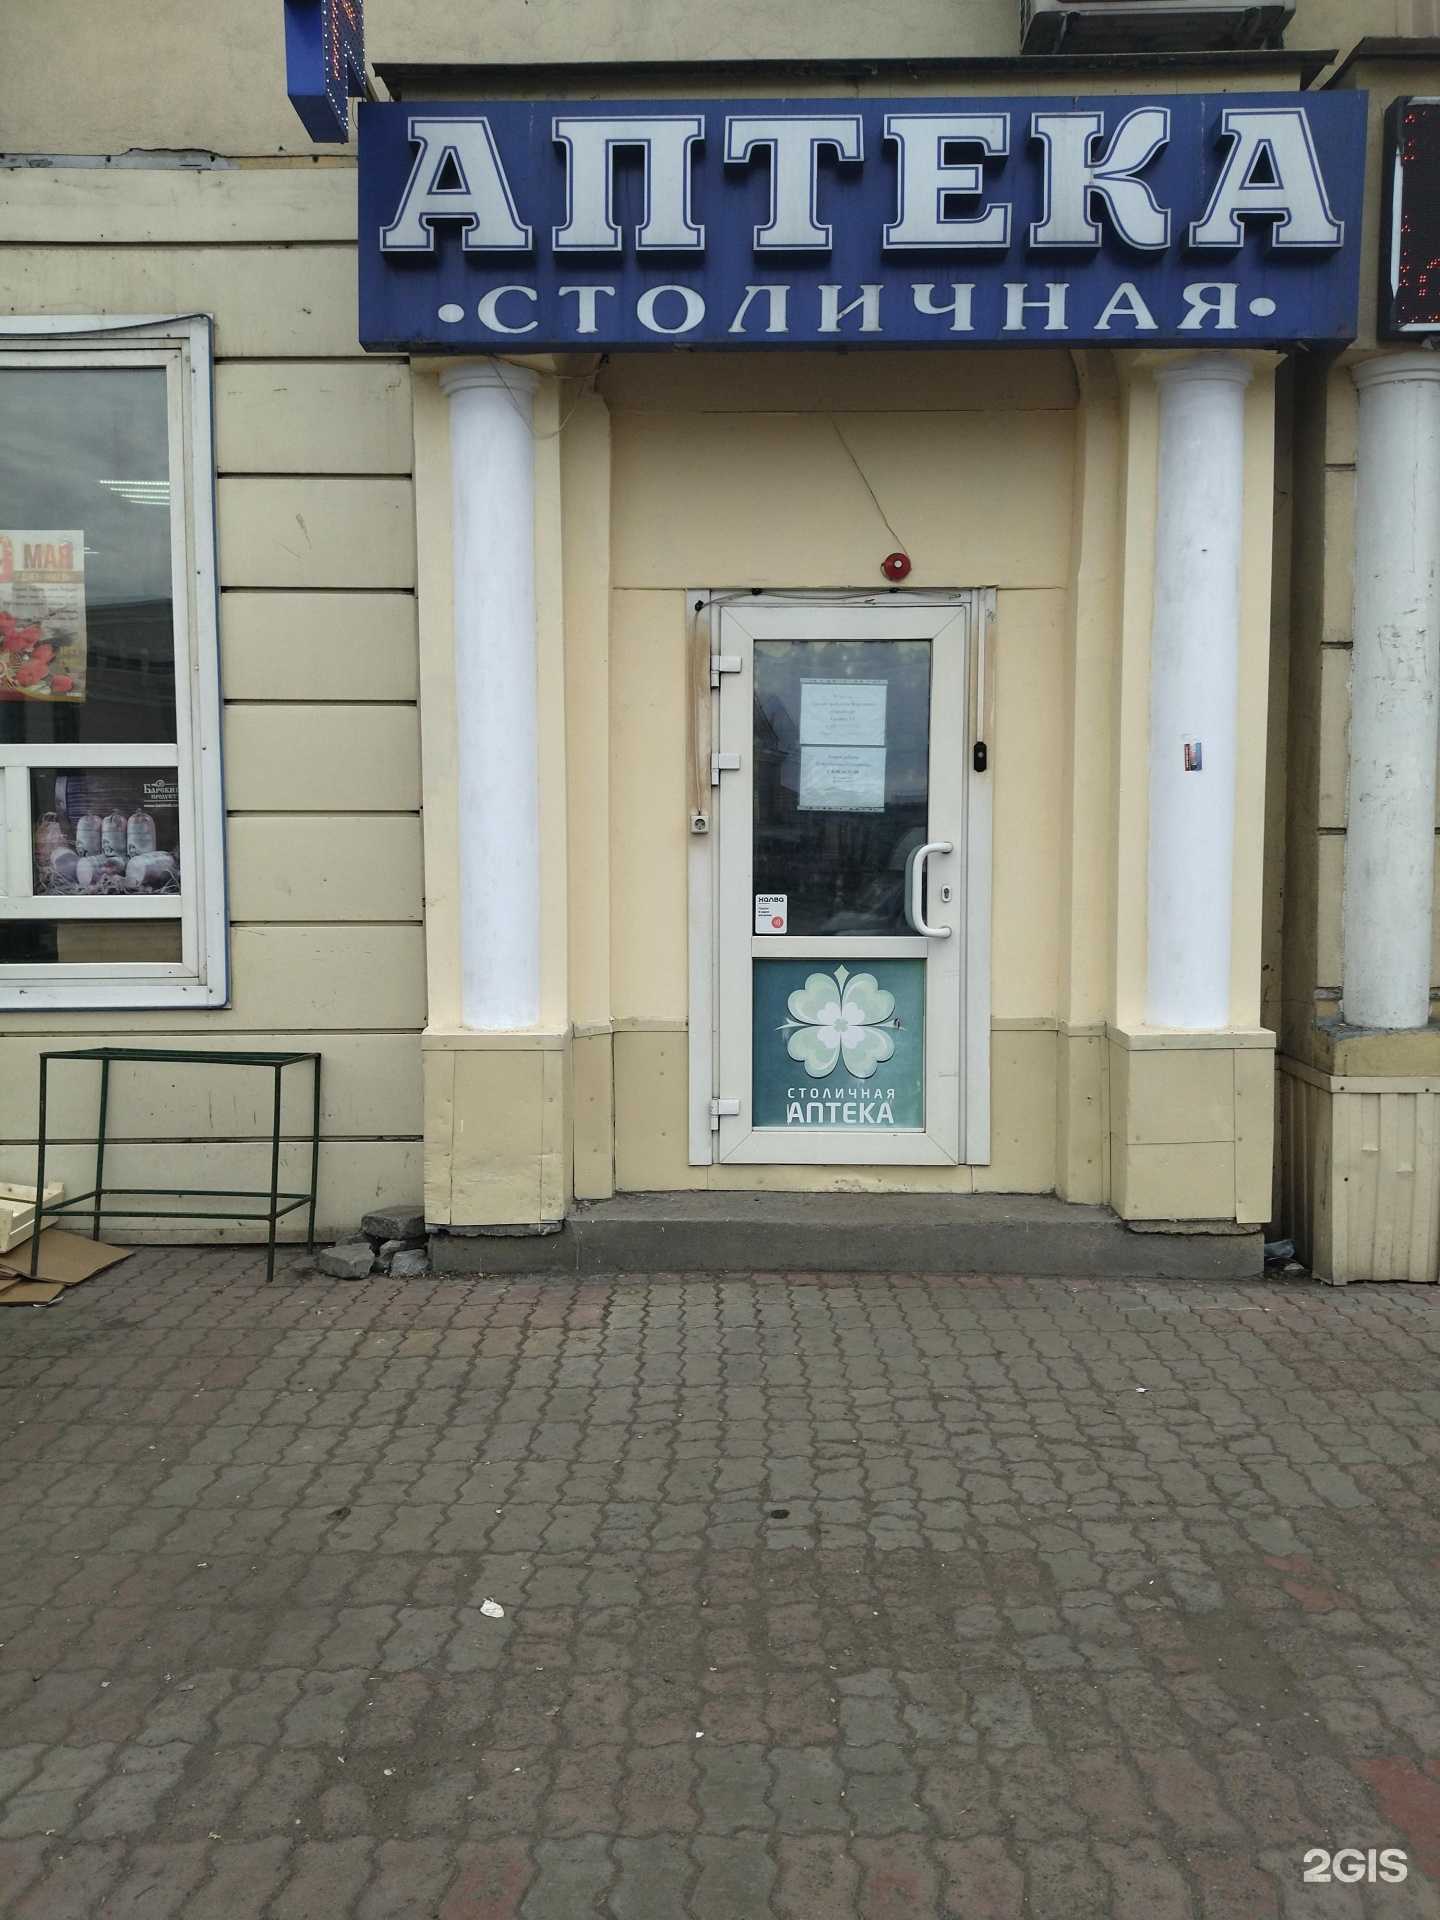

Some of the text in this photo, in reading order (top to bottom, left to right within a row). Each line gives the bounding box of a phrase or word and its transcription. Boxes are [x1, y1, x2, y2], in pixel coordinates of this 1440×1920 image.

[380, 106, 1345, 252] АПТЕКА
[477, 281, 1240, 335] СТОЛИЧНАЯ
[787, 1087, 895, 1099] СТОЛИЧНАЯ
[786, 1101, 895, 1124] АПТЕКА
